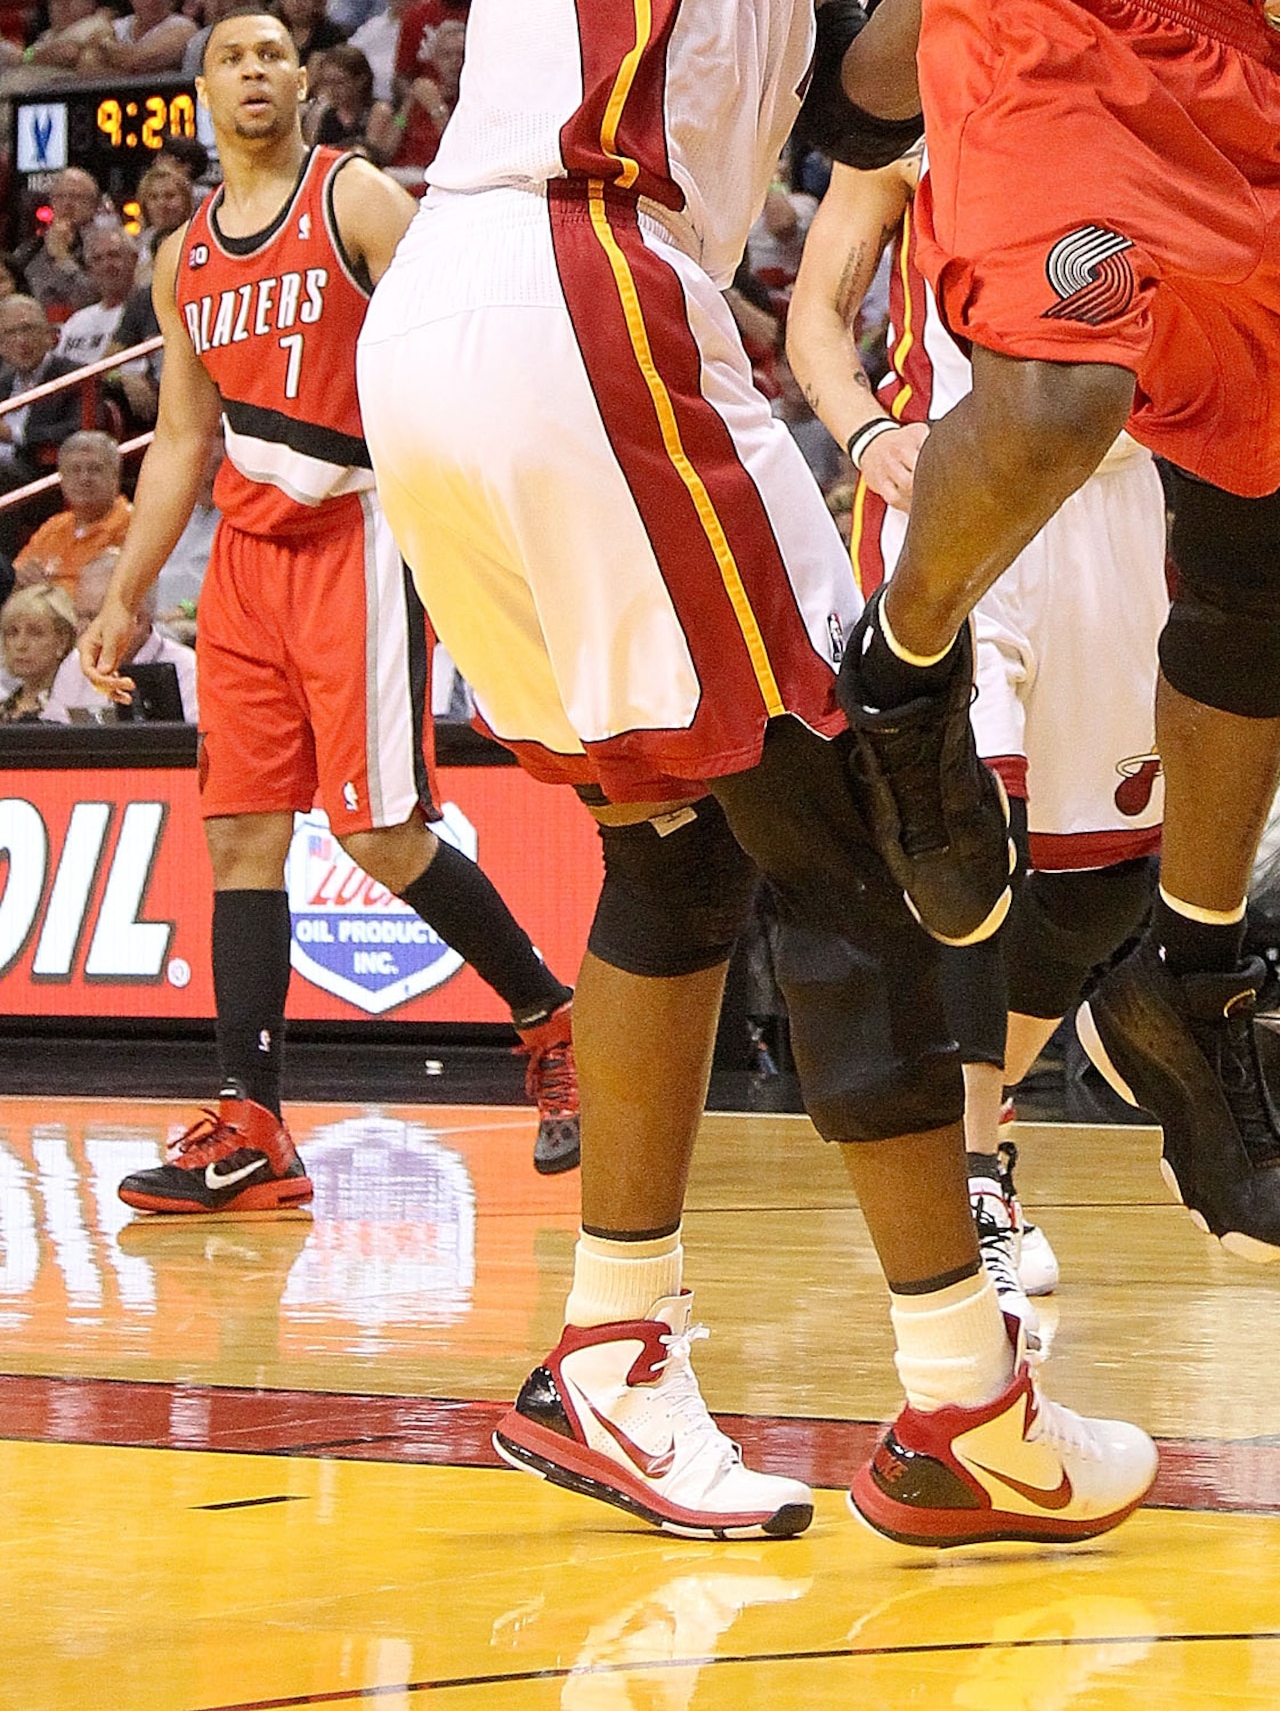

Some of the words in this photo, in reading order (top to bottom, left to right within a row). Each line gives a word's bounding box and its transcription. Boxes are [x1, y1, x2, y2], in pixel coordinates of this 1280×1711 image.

[184, 267, 328, 356] BLAZERS
[278, 333, 305, 400] 7
[295, 920, 335, 944] OIL
[337, 920, 448, 945] PRODUCT
[353, 950, 400, 976] INC.
